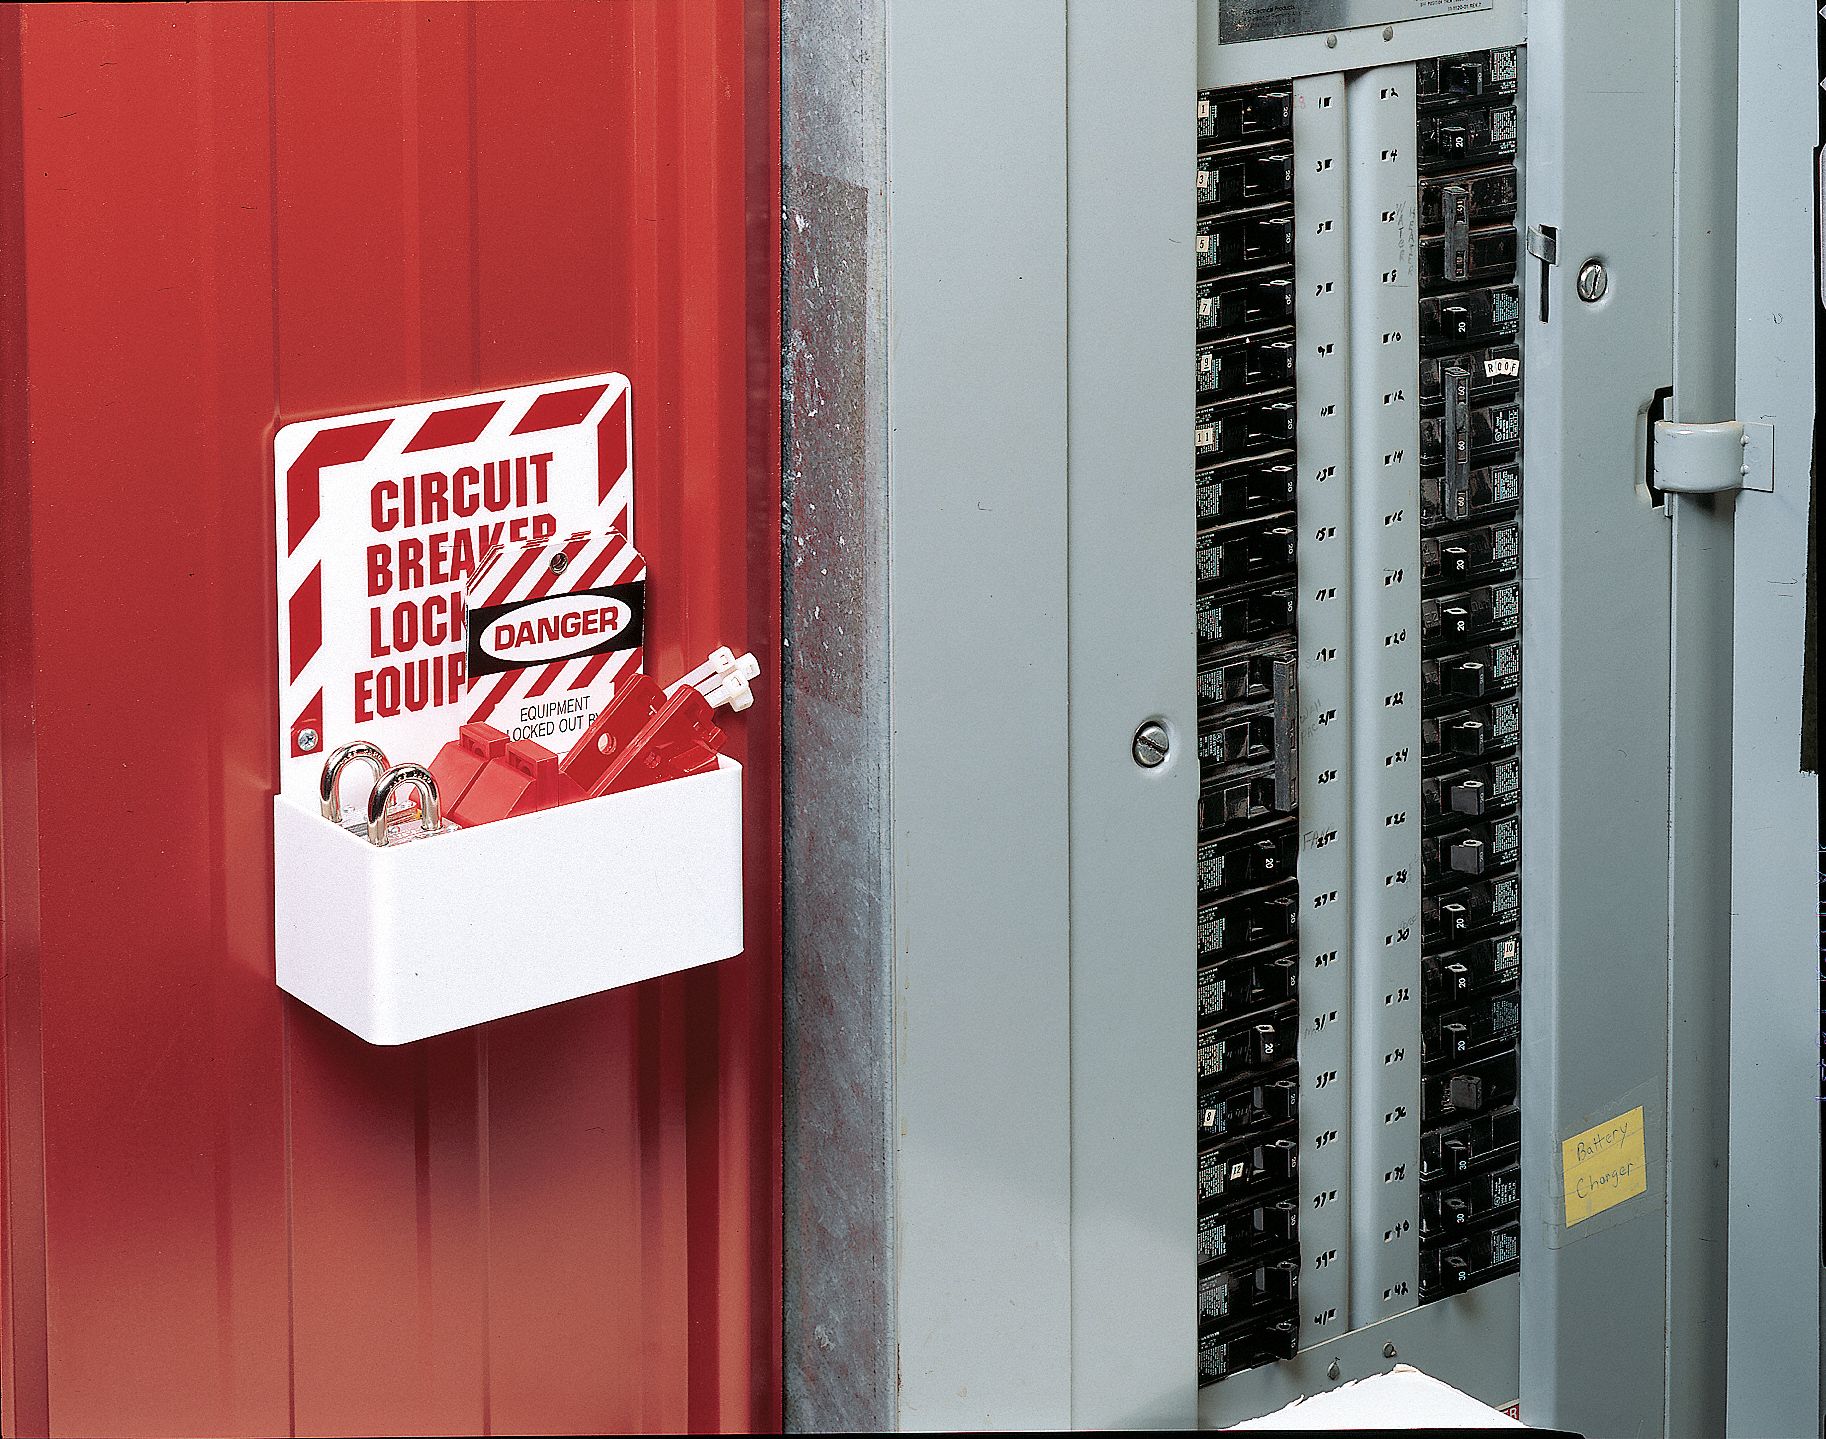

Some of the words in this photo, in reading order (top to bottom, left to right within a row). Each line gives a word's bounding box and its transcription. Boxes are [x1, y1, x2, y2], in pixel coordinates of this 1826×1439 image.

[1390, 87, 1398, 97] 2
[1319, 97, 1322, 109] 1
[1455, 136, 1464, 148] 20
[1390, 149, 1397, 162] 4
[1316, 161, 1323, 172] 3
[1316, 222, 1324, 234] 5
[1316, 285, 1323, 296] 7
[1458, 321, 1466, 333] 20
[1391, 332, 1401, 342] 10
[1318, 345, 1325, 357] 9
[1487, 361, 1516, 375] ROOF
[1394, 390, 1404, 401] 12
[1320, 407, 1327, 417] 11
[1457, 440, 1466, 451] 60
[1393, 450, 1403, 463] 14
[1316, 468, 1328, 482] 13
[370, 452, 553, 532] CIRCUIT
[1392, 510, 1403, 521] 16
[1456, 559, 1465, 570] 20
[1316, 589, 1326, 601] 17
[494, 606, 618, 651] DANGER
[1456, 620, 1465, 632] 20
[1393, 629, 1406, 644] 20
[520, 695, 590, 723] EQUIPMENT
[559, 715, 584, 733] OUT
[588, 712, 599, 728] B
[1318, 711, 1329, 725] 21
[1395, 748, 1408, 762] 24
[1393, 812, 1405, 824] 26
[1265, 858, 1273, 869] 20
[1395, 869, 1407, 883] 28
[1314, 893, 1328, 908] 27
[1456, 918, 1465, 929] 20
[1396, 927, 1409, 943] 30
[1505, 942, 1513, 953] 10
[1315, 953, 1328, 967] 29
[1458, 977, 1466, 989] 20
[1397, 988, 1409, 1002] 32
[1314, 1014, 1326, 1030] 31
[1265, 1043, 1273, 1054] 20
[1457, 1040, 1466, 1051] 20
[1315, 1072, 1329, 1088] 33
[1315, 1131, 1330, 1149] 35
[1577, 1122, 1628, 1161] Battery
[1459, 1160, 1467, 1170] 30
[1576, 1163, 1633, 1199] Charger
[1313, 1192, 1326, 1209] 37
[1457, 1213, 1465, 1224] 30
[1395, 1220, 1409, 1237] 40
[1315, 1252, 1328, 1269] 39
[1458, 1271, 1466, 1281] 30
[1394, 1281, 1408, 1296] 42
[1314, 1310, 1327, 1325] 41
